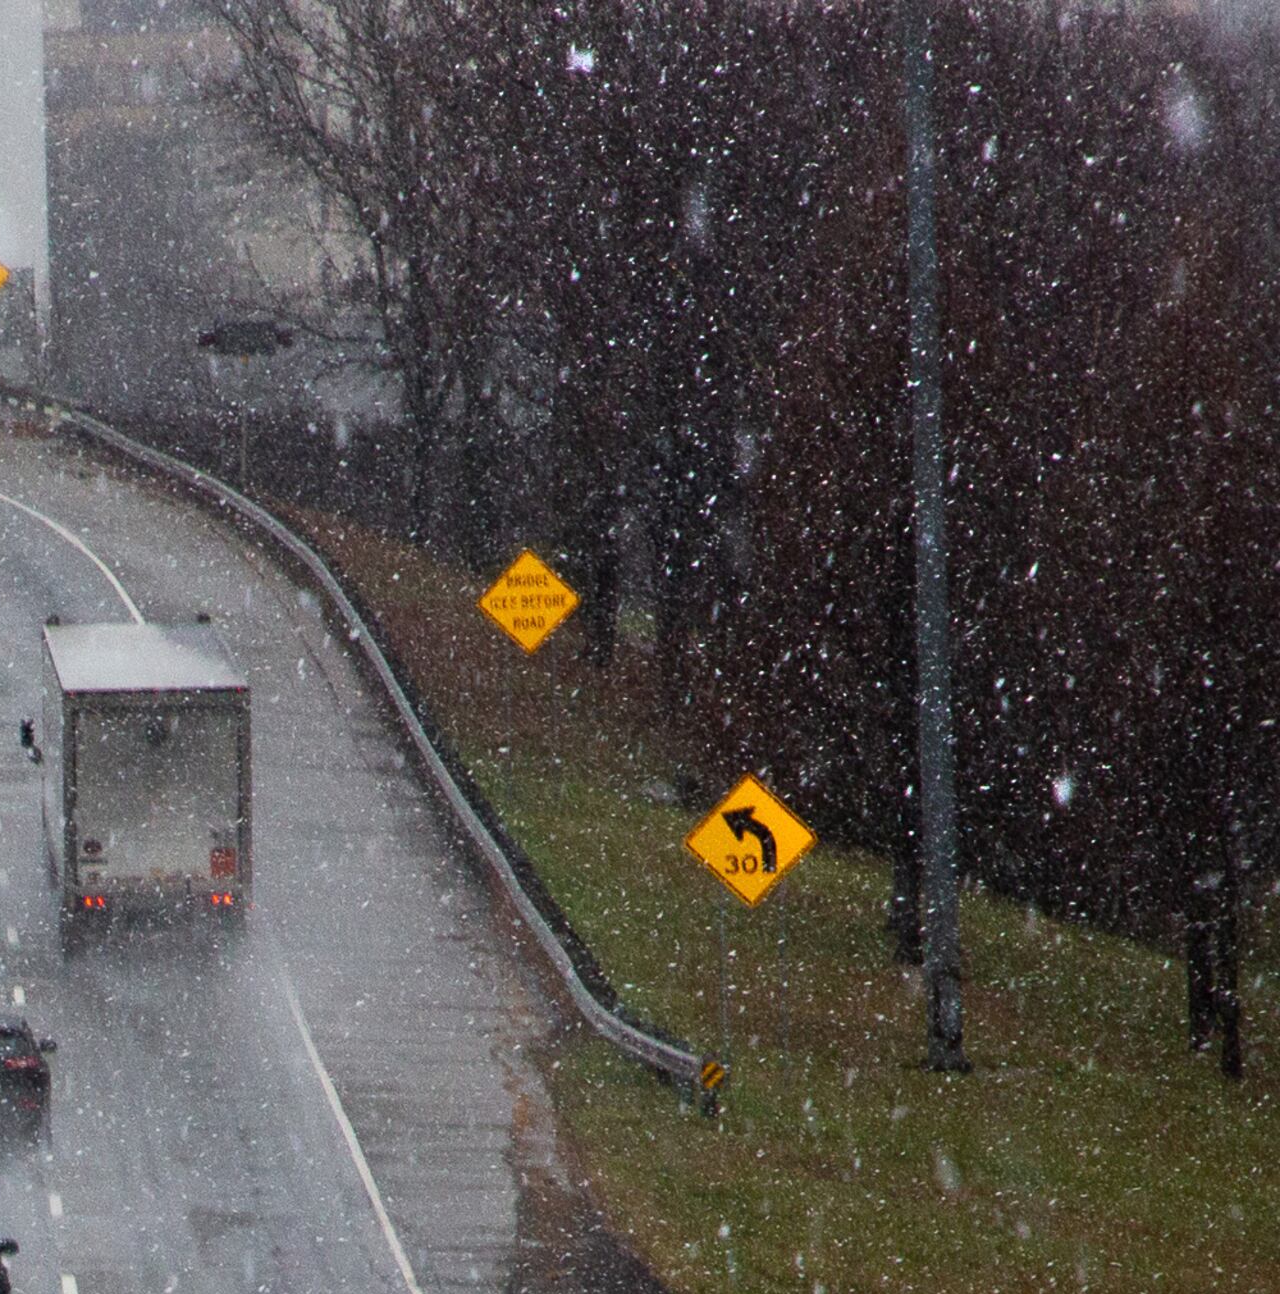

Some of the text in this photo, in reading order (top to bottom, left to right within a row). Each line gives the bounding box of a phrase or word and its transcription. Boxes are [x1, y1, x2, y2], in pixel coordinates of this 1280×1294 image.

[506, 574, 548, 588] BRIDGE
[490, 593, 566, 610] ICES BEFORE
[513, 616, 545, 631] ROAD
[725, 854, 758, 875] 30
